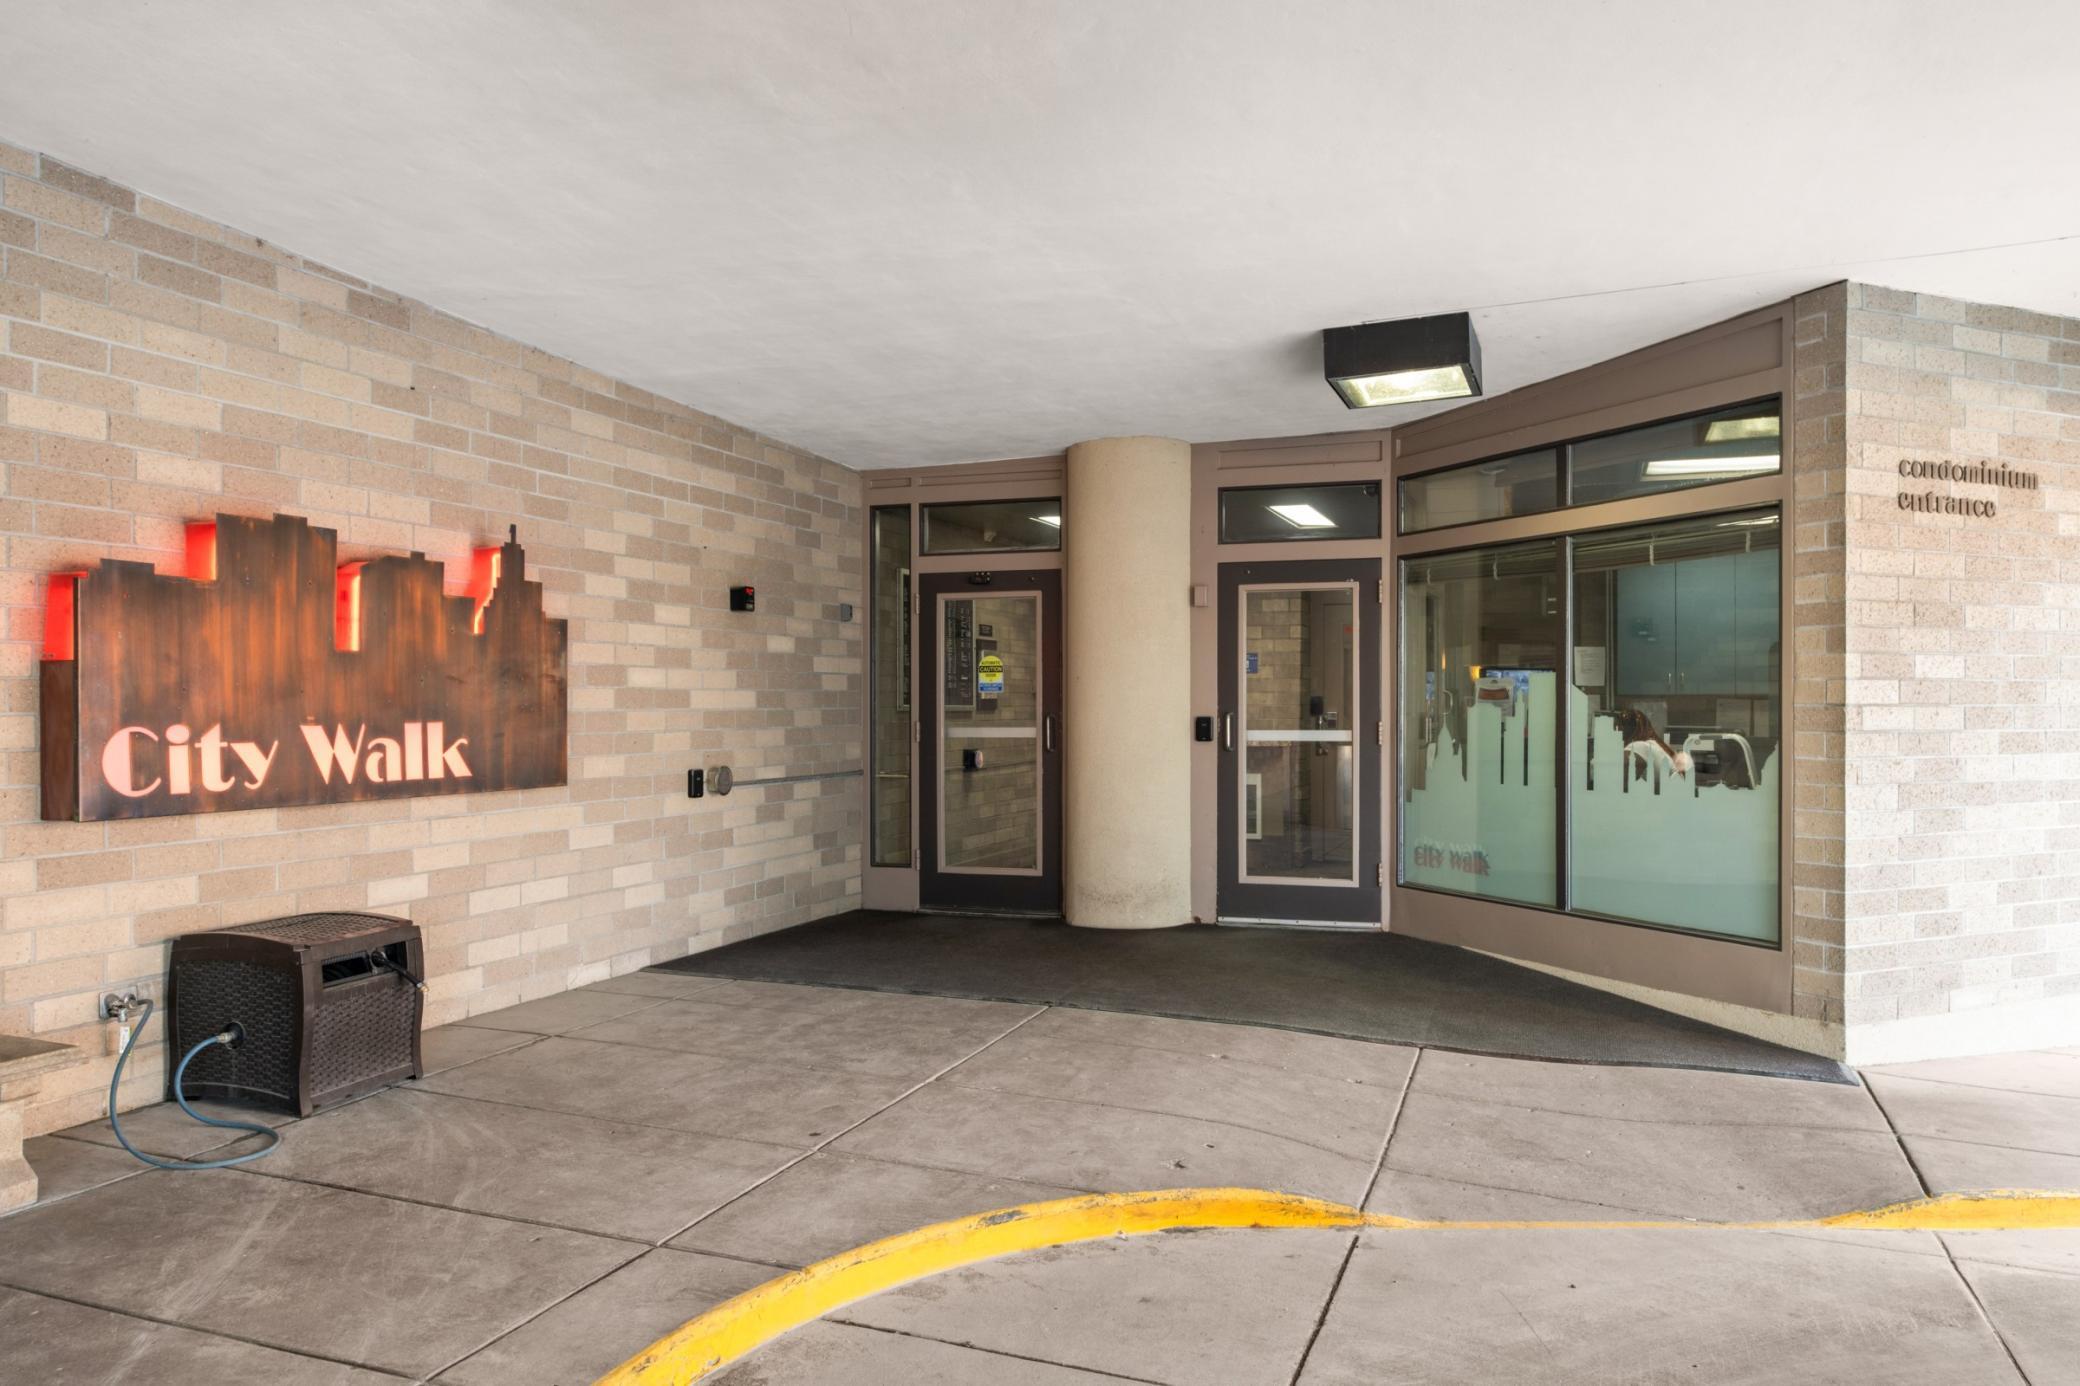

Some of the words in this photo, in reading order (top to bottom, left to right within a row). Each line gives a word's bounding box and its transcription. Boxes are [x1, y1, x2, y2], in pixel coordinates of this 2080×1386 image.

[1899, 459, 2038, 490] condominium
[1898, 491, 1996, 518] entrance
[101, 723, 278, 797] City
[299, 721, 473, 785] Walk
